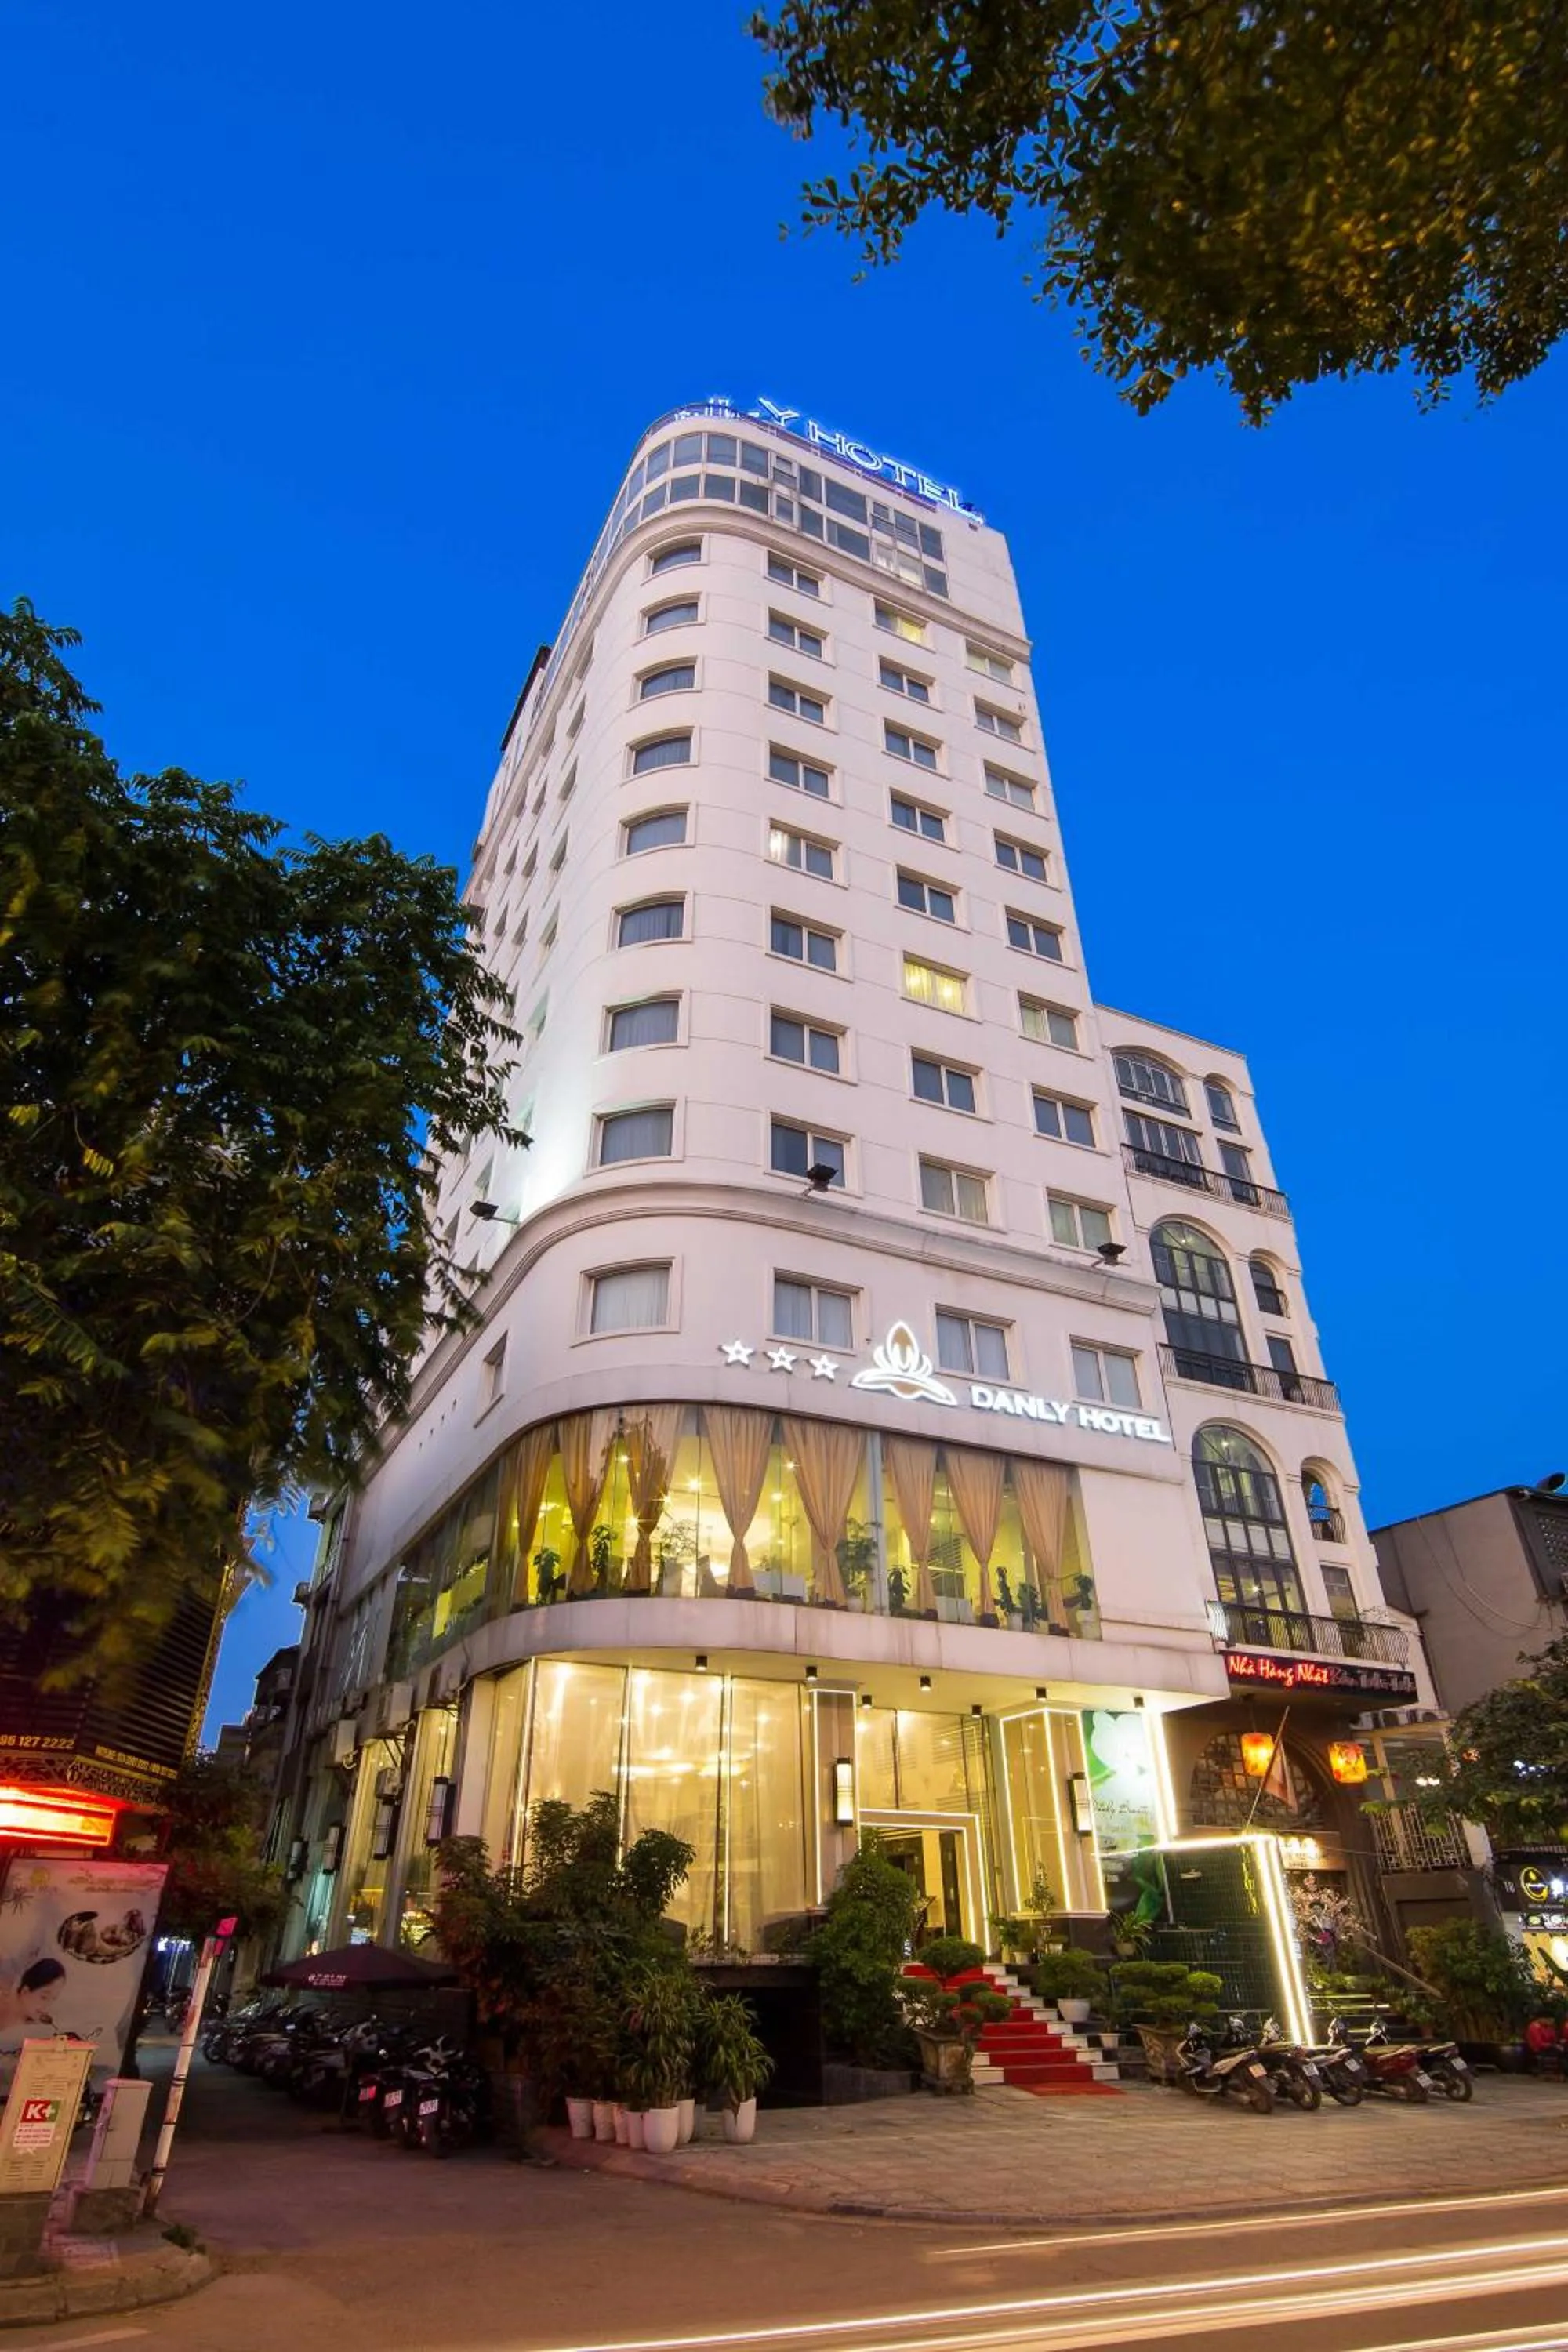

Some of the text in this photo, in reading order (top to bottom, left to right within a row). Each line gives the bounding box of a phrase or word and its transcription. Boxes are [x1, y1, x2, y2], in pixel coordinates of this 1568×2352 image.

[808, 419, 984, 524] HOTEL
[970, 1385, 1171, 1443] DANLY HOTEL
[41, 1737, 75, 1749] 2222
